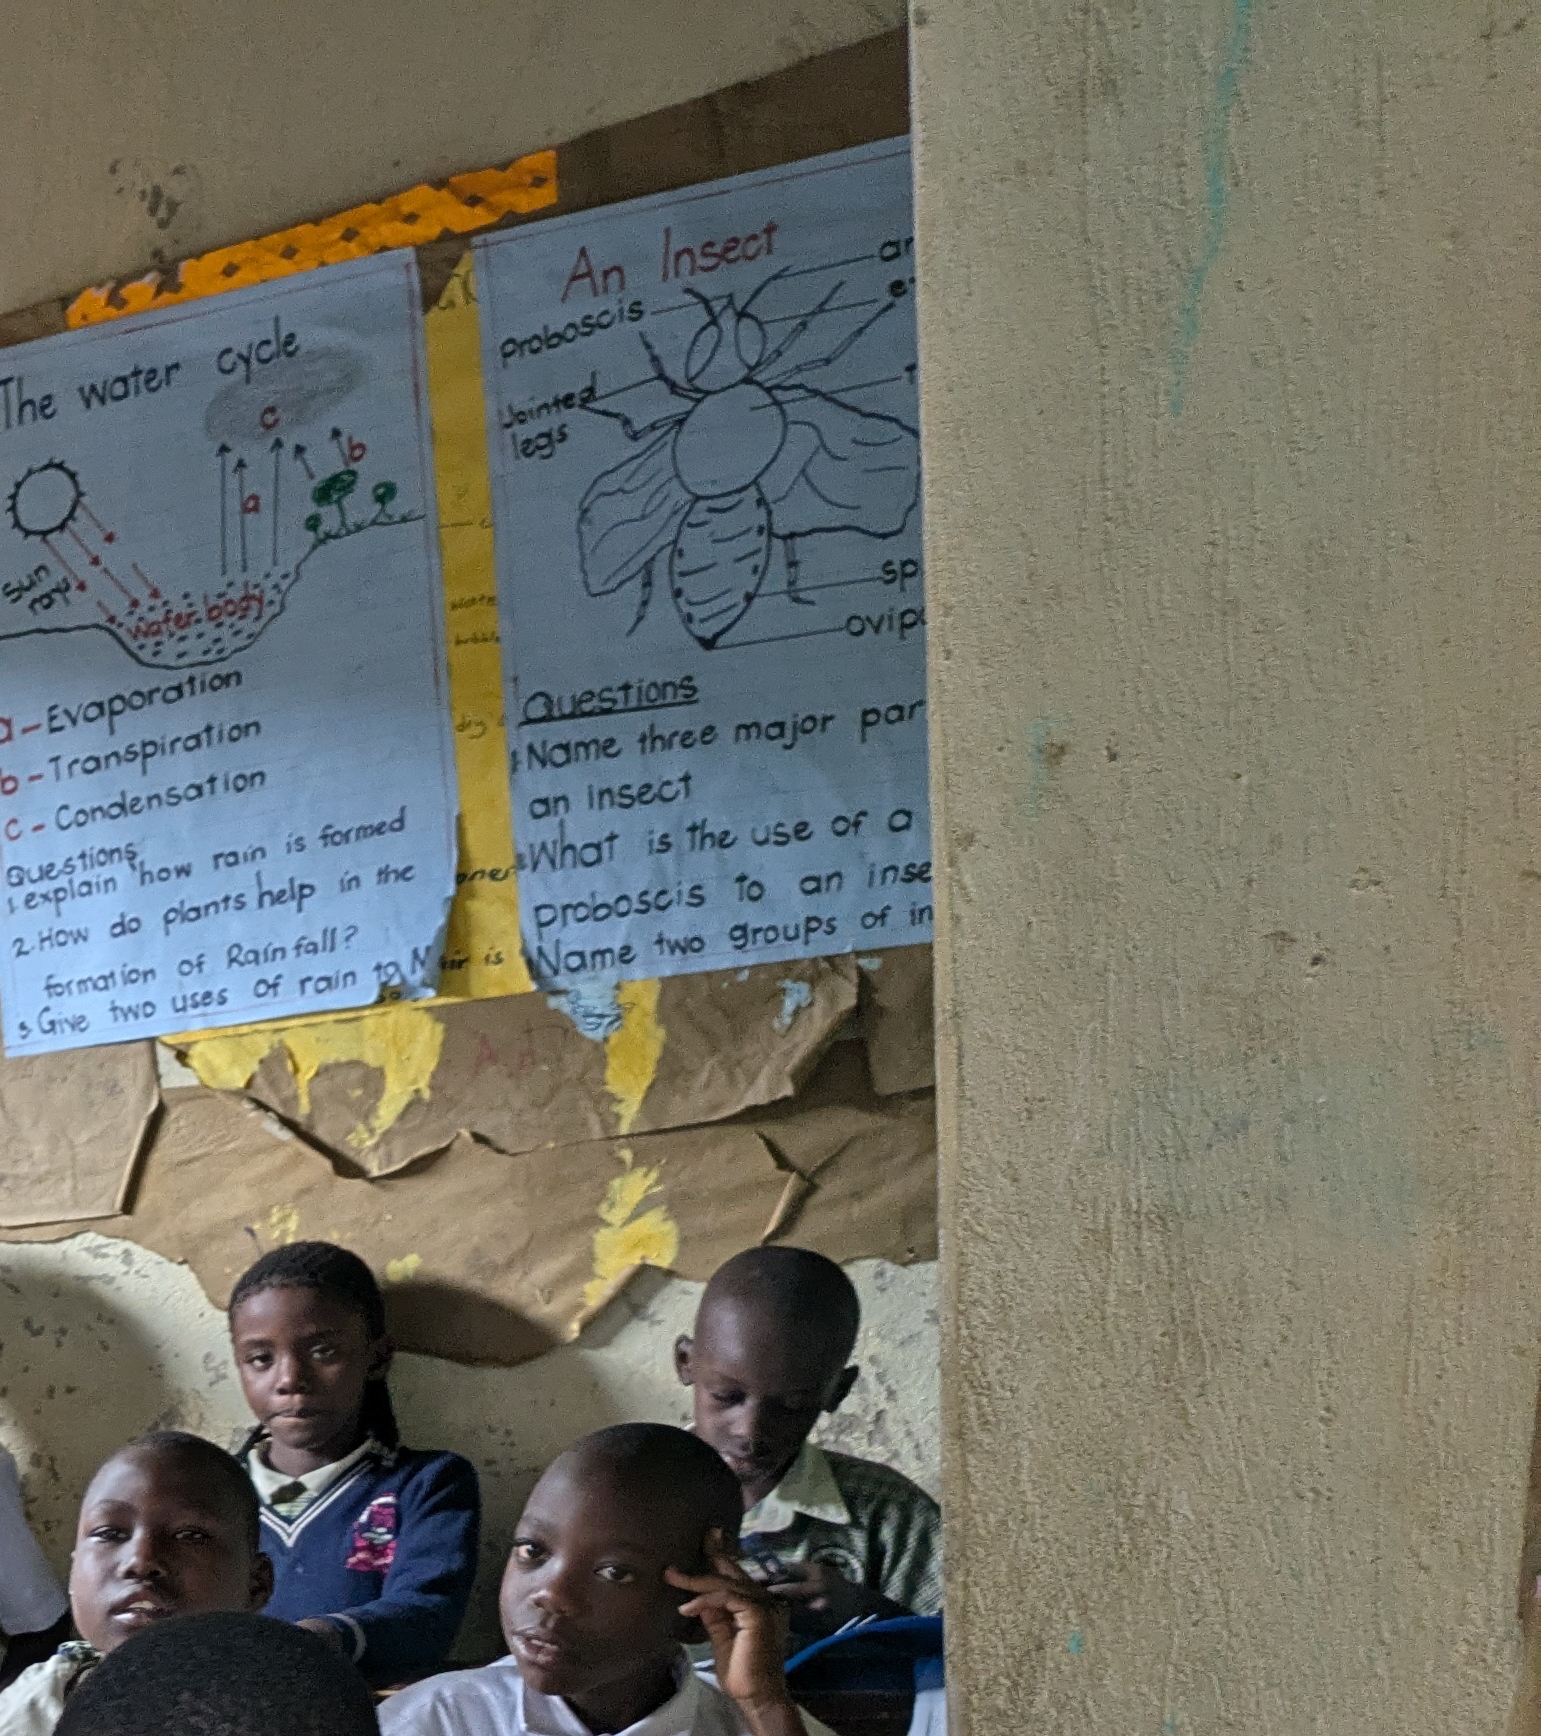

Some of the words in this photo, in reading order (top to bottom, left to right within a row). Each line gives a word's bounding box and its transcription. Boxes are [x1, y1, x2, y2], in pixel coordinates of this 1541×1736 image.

[560, 246, 627, 303] An
[661, 220, 779, 283] Insect
[78, 355, 182, 410] water
[216, 315, 301, 385] cycle
[500, 299, 646, 368] proboscis
[514, 421, 569, 460] legs
[126, 598, 197, 642] water
[205, 579, 267, 624] body
[47, 667, 244, 735] Evaporation
[521, 674, 700, 723] Questions
[49, 717, 263, 784] Transpiration
[525, 735, 623, 772] Name
[637, 720, 718, 756] three
[733, 710, 837, 751] major
[53, 767, 267, 832] Condensation
[528, 793, 570, 820] an
[586, 770, 693, 808] insect
[6, 839, 138, 888] Questions
[212, 842, 268, 872] rain
[285, 831, 307, 856] is
[319, 804, 407, 849] formed
[529, 818, 621, 874] What
[647, 829, 672, 855] is
[687, 818, 737, 852] the
[751, 823, 813, 848] use
[830, 809, 869, 838] of
[109, 914, 142, 940] do
[162, 884, 248, 937] plants
[254, 871, 317, 913] help
[338, 869, 362, 896] in
[376, 863, 417, 887] the
[532, 880, 707, 942] proboscis
[733, 874, 766, 904] to
[799, 869, 844, 896] an
[43, 961, 158, 1001] formation
[177, 949, 207, 977] of
[534, 942, 637, 979] Name
[653, 931, 706, 957] two
[728, 914, 839, 951] groups
[859, 905, 893, 932] of
[37, 1004, 91, 1037] Give
[108, 998, 157, 1022] two
[170, 988, 229, 1013] uses
[252, 975, 283, 1000] of
[299, 967, 358, 997] rain
